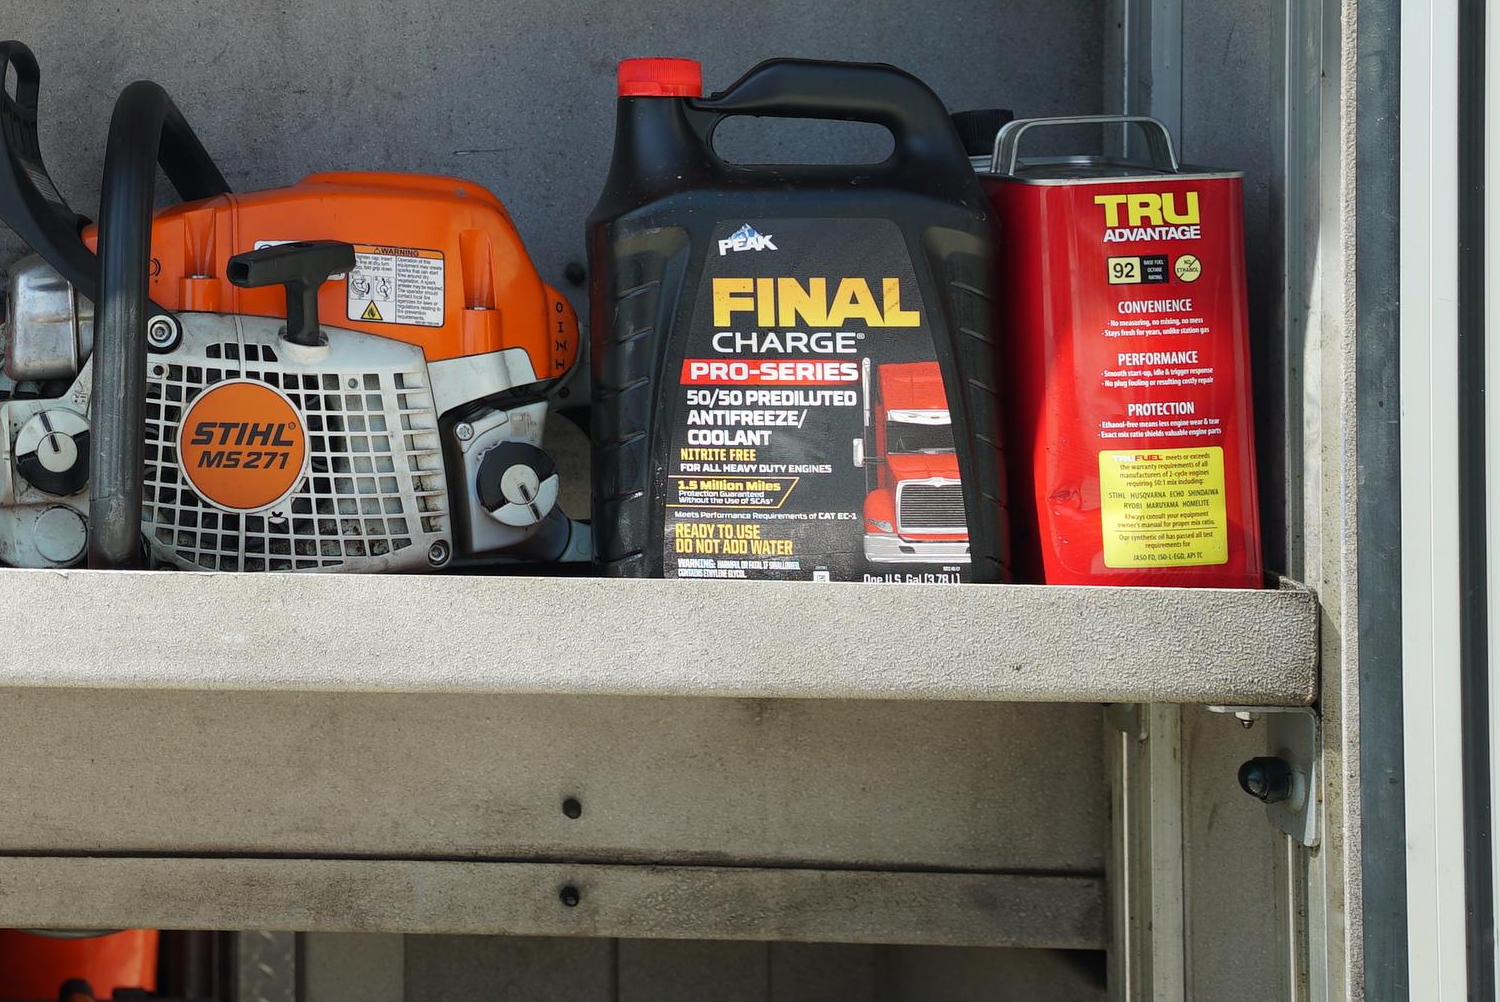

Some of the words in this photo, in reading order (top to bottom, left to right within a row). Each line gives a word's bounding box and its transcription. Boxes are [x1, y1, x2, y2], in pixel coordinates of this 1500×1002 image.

[1094, 192, 1200, 227] TRU
[1103, 226, 1201, 243] ADVANTAGE
[381, 248, 419, 256] WARNING
[718, 233, 778, 256] PEAK
[1113, 263, 1134, 278] 92
[712, 277, 921, 327] FINAL
[1118, 299, 1192, 313] CONVENIENCE
[1105, 329, 1120, 337] Stays
[1118, 351, 1198, 366] PERFORMANCE
[691, 363, 858, 381] PRO-SERIES
[687, 388, 742, 408] 50/50
[746, 390, 857, 406] PREDILUTED
[1128, 402, 1194, 416] PROTECTION
[687, 409, 807, 429] ANTIFREEZE/
[190, 422, 294, 446] STIHL
[687, 430, 772, 445] COOLANT
[681, 448, 726, 461] NITRITE
[730, 449, 756, 461] FREE
[680, 464, 701, 472] FOR
[702, 464, 722, 472] ALL
[723, 464, 757, 473] HEAVY
[759, 464, 787, 473] DUTY
[789, 464, 832, 473] ENGINES
[678, 480, 697, 490] 1.5
[700, 480, 743, 490] Million
[746, 480, 781, 491] Miles
[679, 490, 718, 498] Protection
[741, 497, 749, 505] of
[753, 512, 807, 520] Requirements
[818, 512, 836, 520] CAT
[838, 512, 856, 520] EC-1
[676, 524, 714, 538] READY
[737, 524, 760, 539] USE
[676, 539, 693, 553] DO
[697, 539, 720, 554] NOT
[723, 539, 748, 554] ADD
[750, 540, 793, 555] WATER
[864, 574, 883, 583] One
